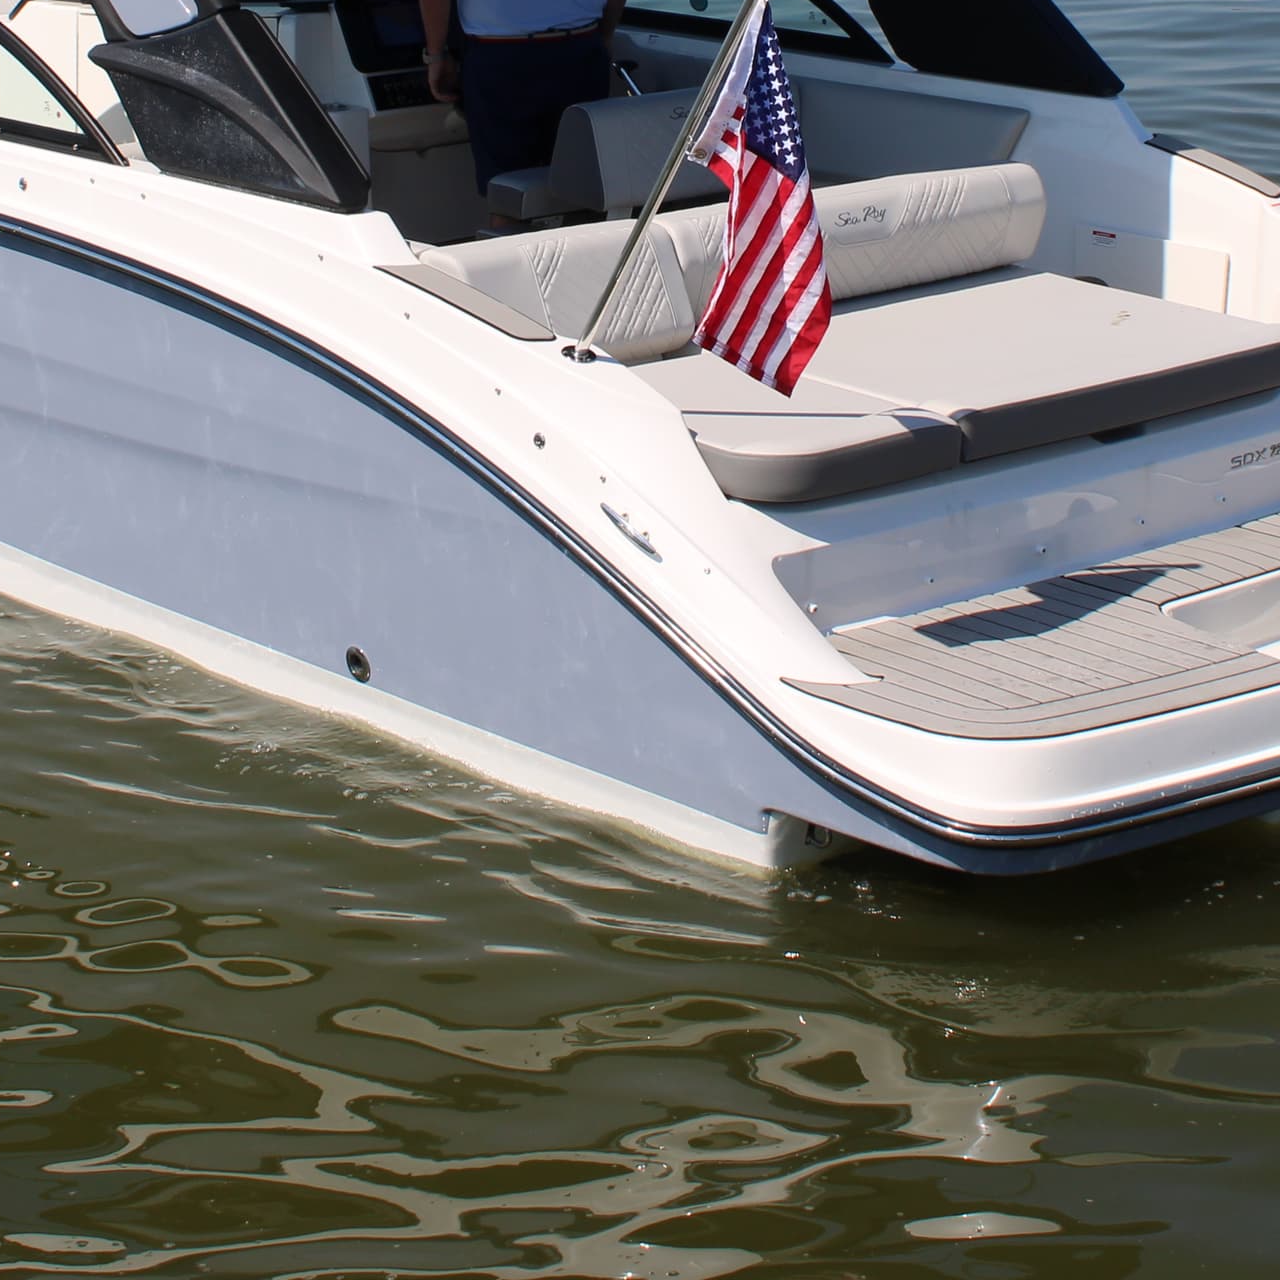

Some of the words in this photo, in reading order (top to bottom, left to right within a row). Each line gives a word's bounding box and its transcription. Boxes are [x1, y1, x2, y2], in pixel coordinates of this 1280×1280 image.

[834, 211, 861, 227] Sea
[862, 205, 887, 223] Ray
[1230, 447, 1267, 469] SDX
